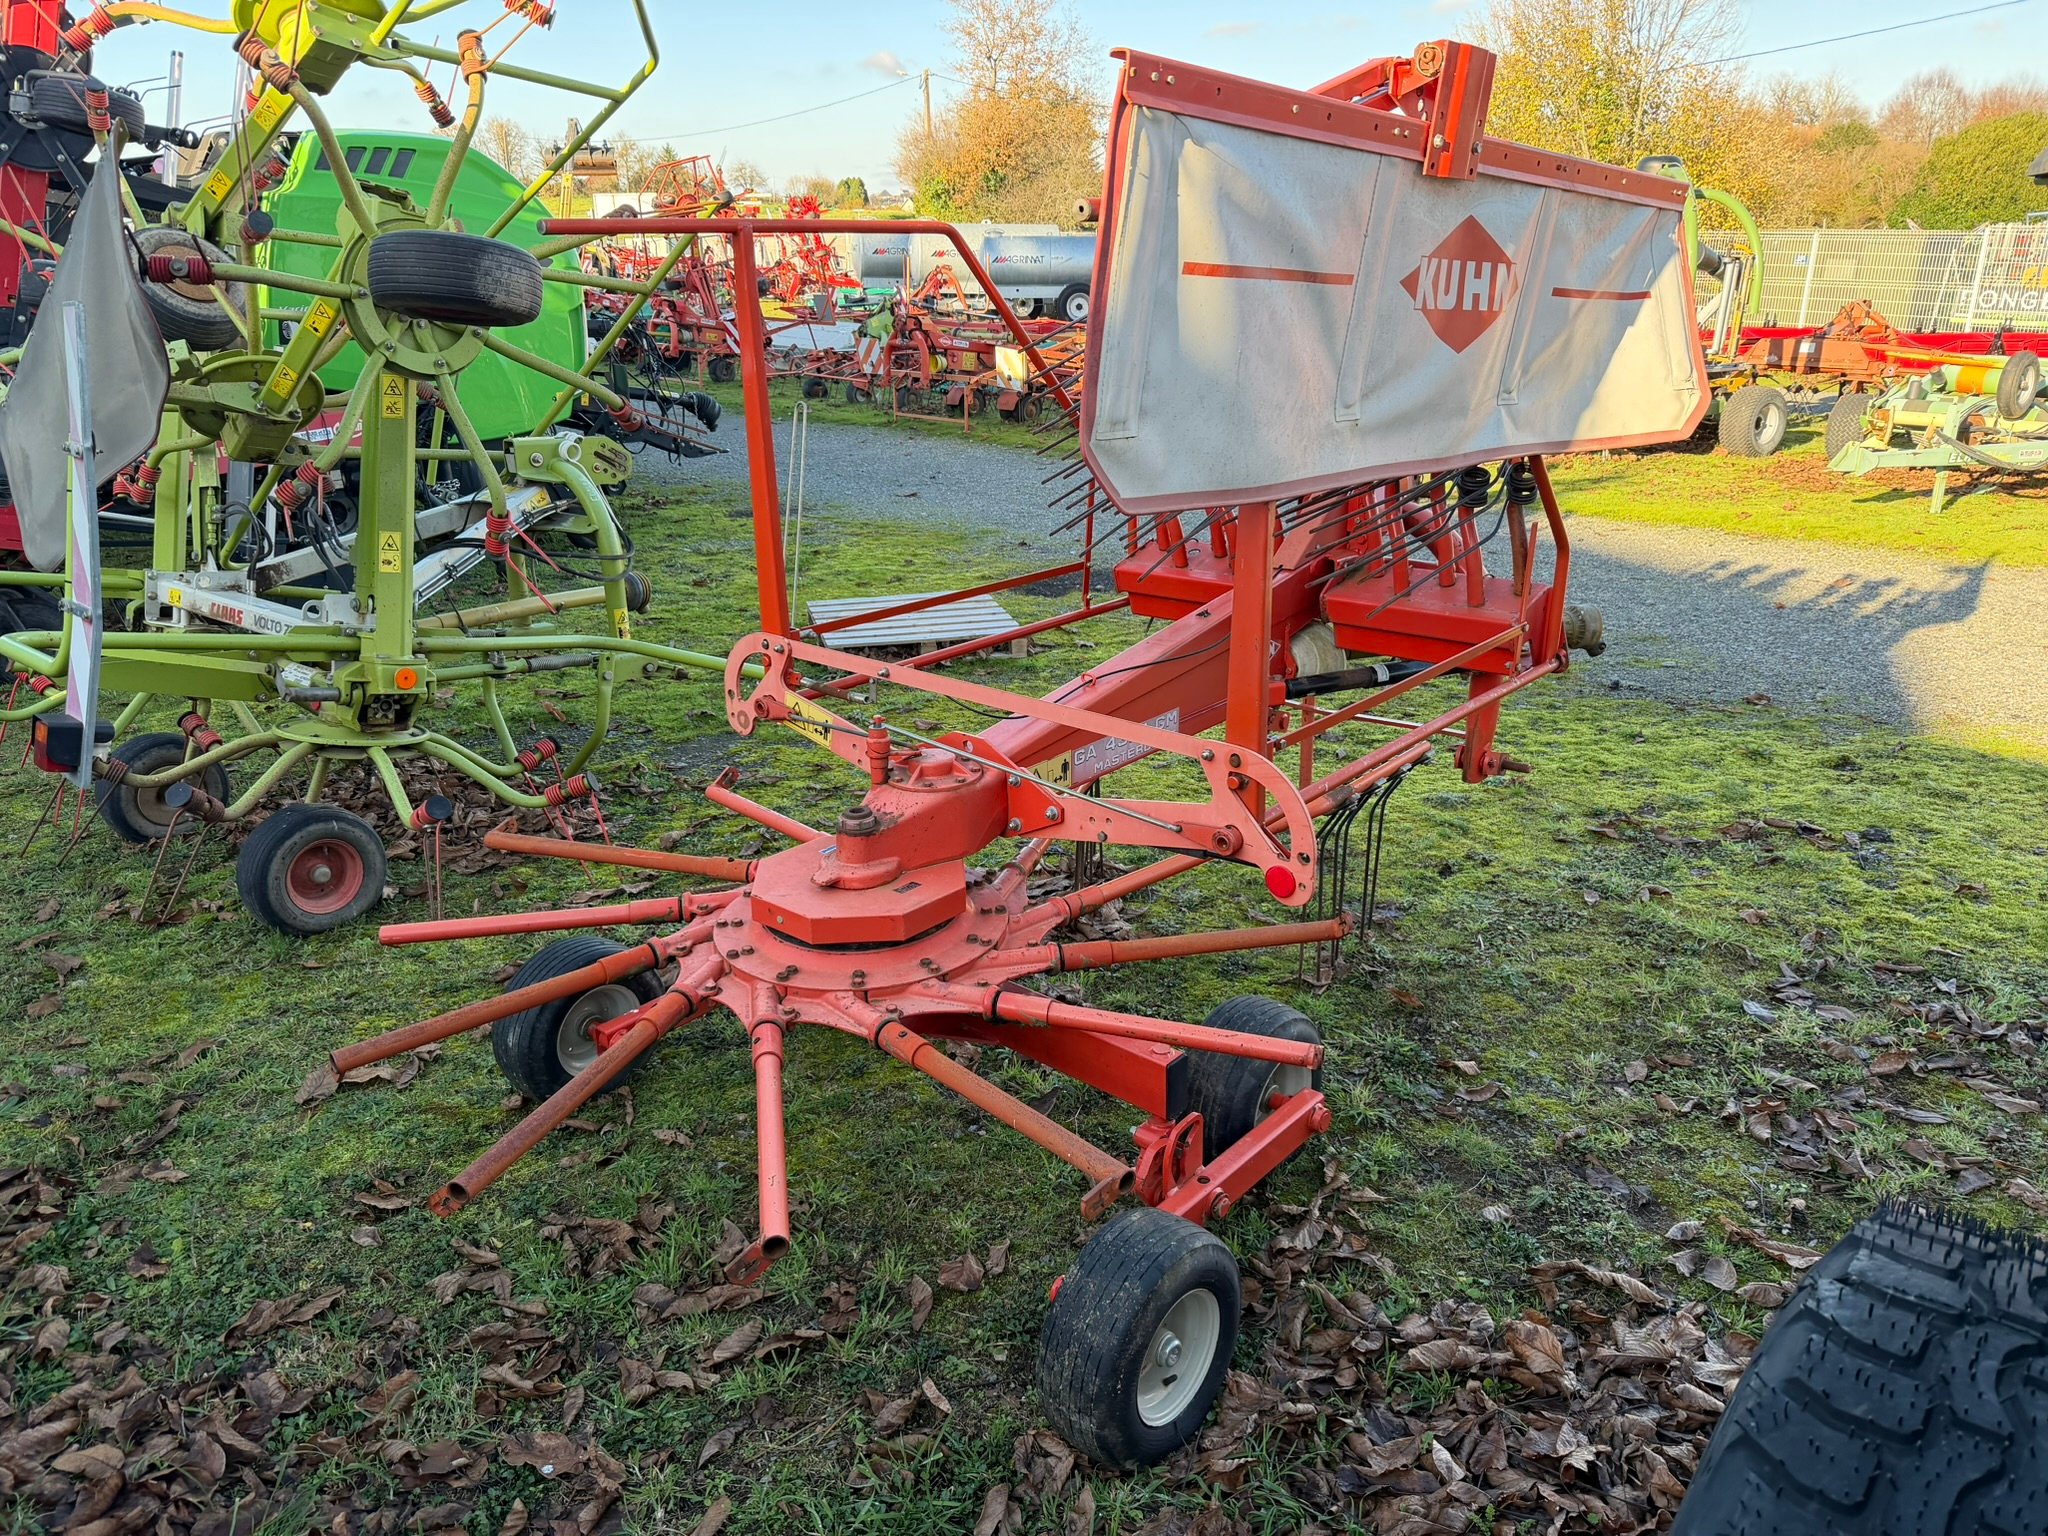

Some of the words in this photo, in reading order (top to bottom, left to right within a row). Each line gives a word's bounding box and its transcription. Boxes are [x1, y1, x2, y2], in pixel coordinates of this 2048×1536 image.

[1413, 256, 1516, 312] KUHN
[209, 602, 244, 625] CLAAS
[253, 614, 282, 634] VOLTO
[1074, 745, 1097, 765] GA
[1155, 711, 1178, 729] GM
